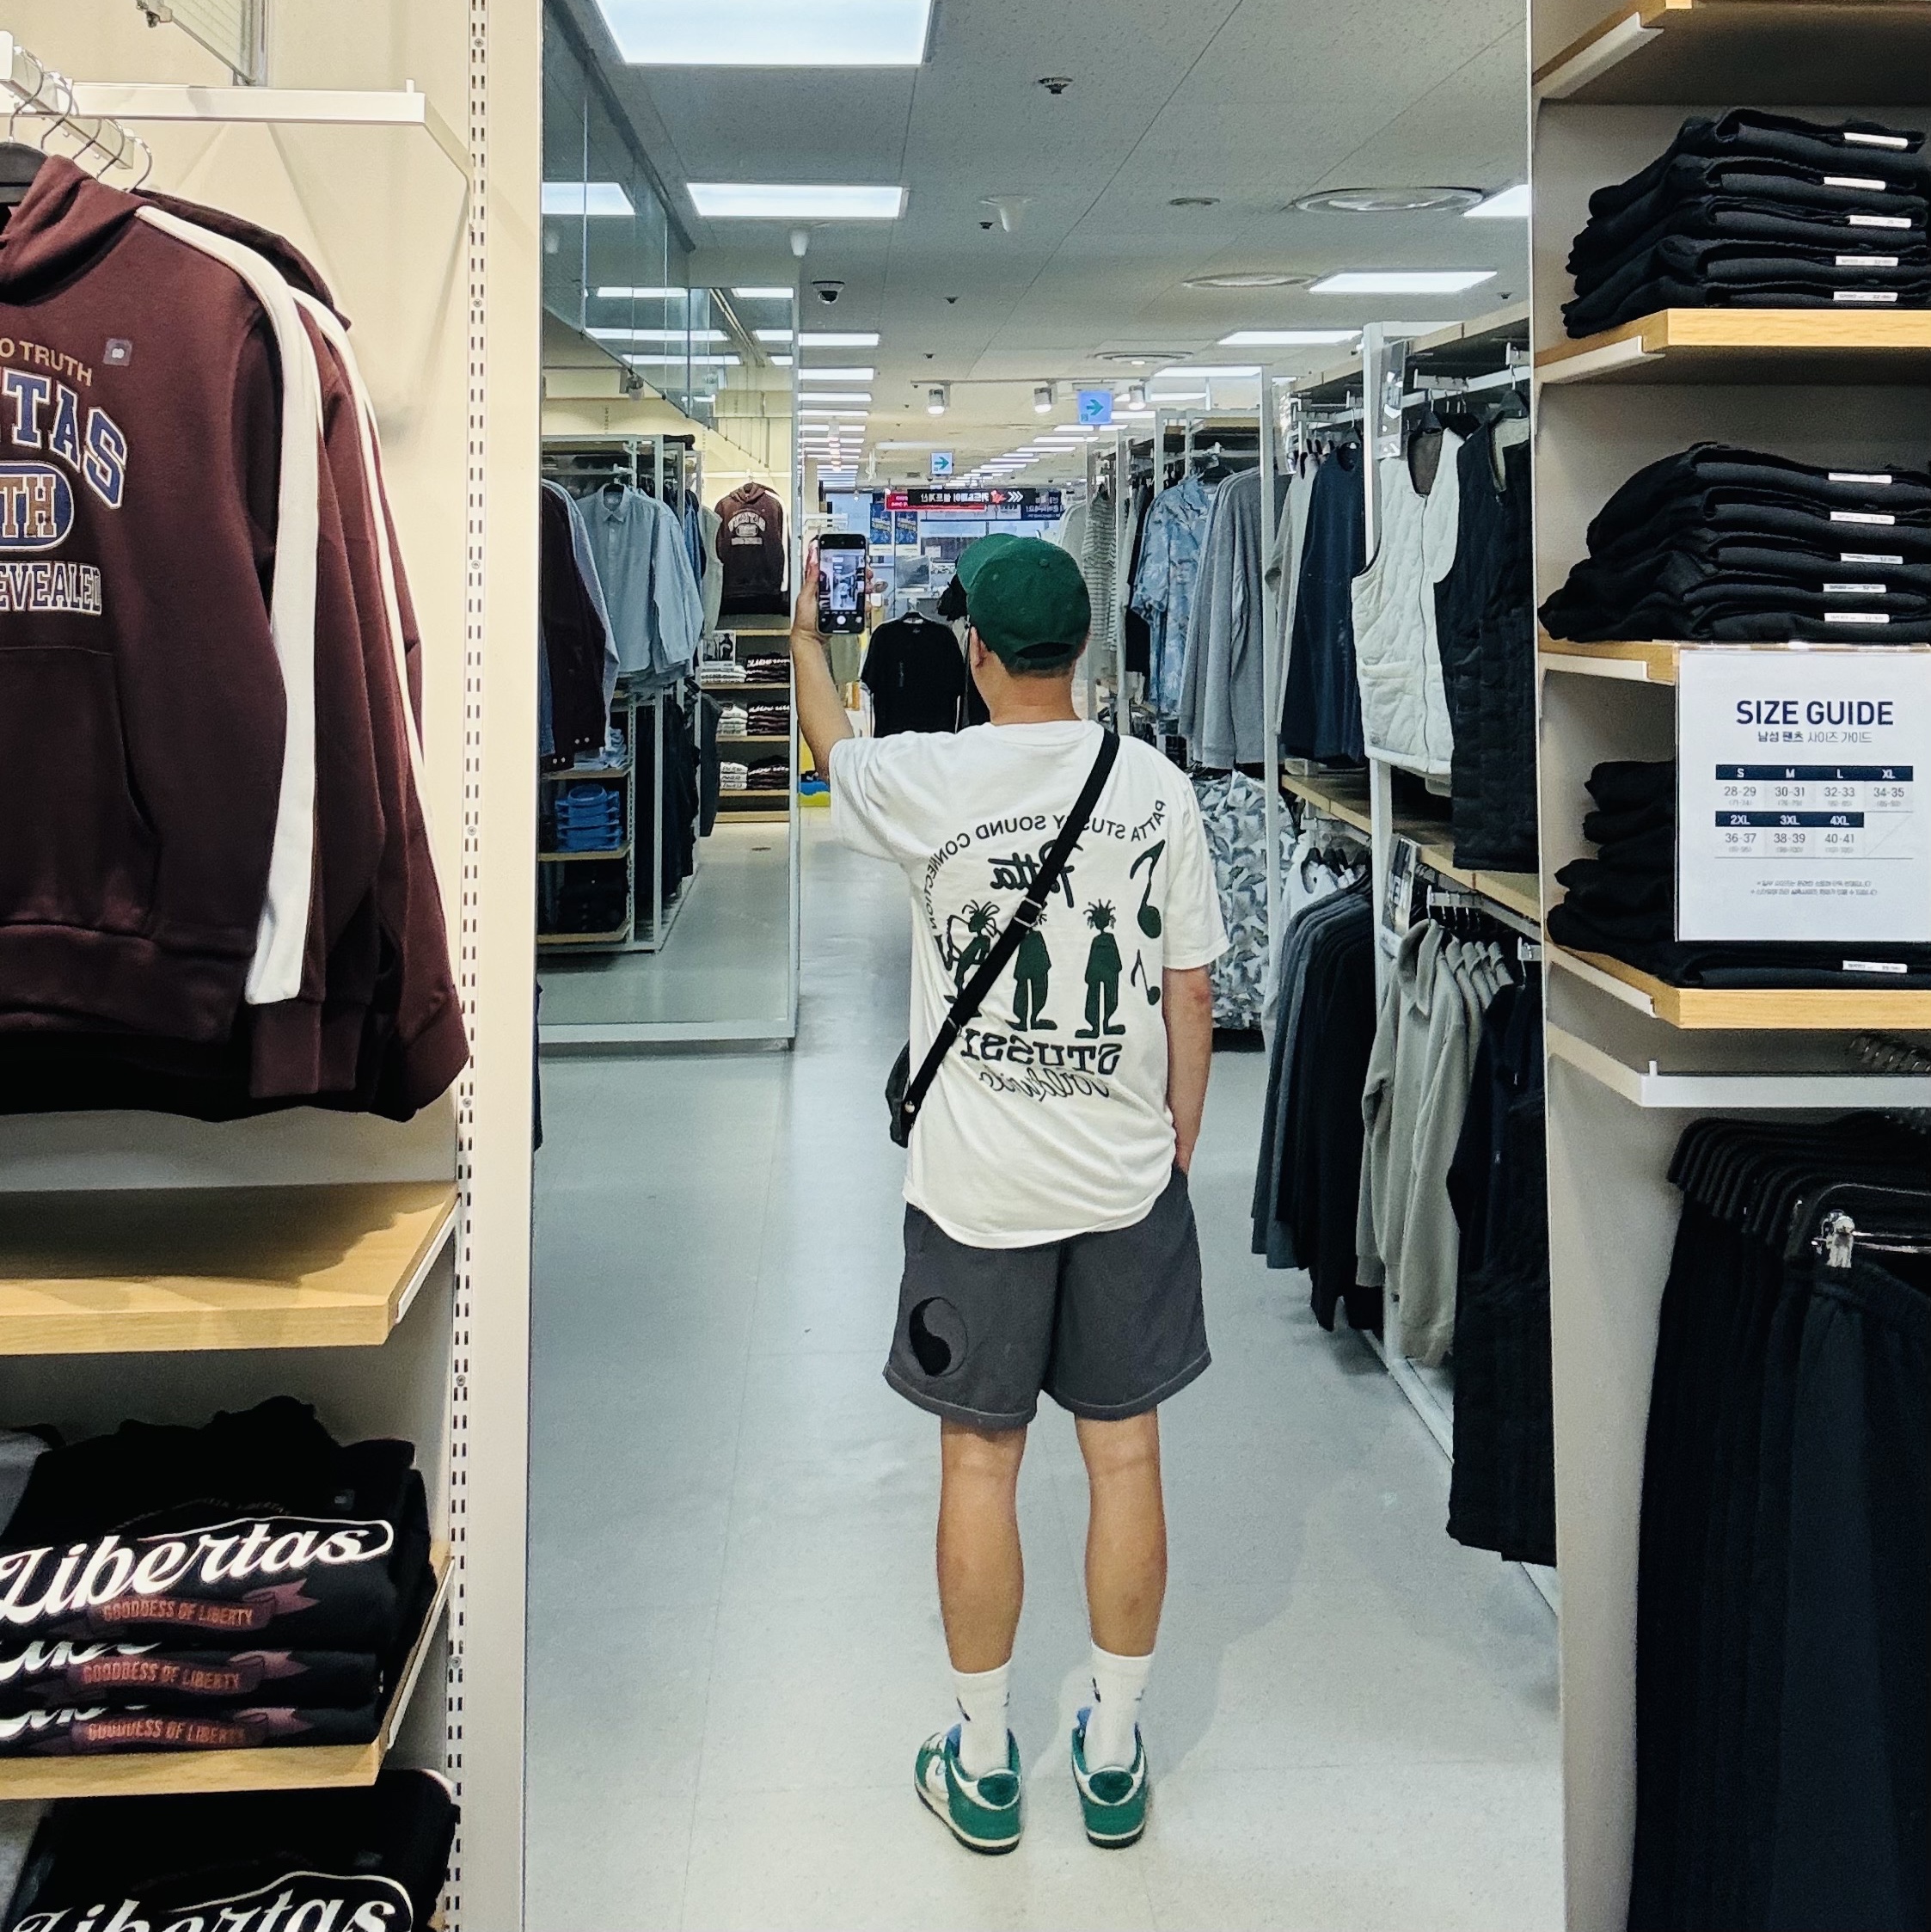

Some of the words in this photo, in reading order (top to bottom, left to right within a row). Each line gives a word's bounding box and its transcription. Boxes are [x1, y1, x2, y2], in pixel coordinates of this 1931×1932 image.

[19, 340, 92, 387] TRUTH
[0, 366, 127, 509] TAS
[1736, 700, 1799, 725] SIZE
[1806, 701, 1894, 725] GUIDE
[1757, 732, 1779, 743] 남성
[1782, 732, 1804, 743] 팬츠
[1808, 732, 1838, 743] 사이즈
[1842, 732, 1873, 744] 가이드
[1737, 768, 1744, 778] S
[1786, 768, 1795, 778] M
[1836, 769, 1843, 779] L
[1882, 769, 1896, 780] XL
[1724, 786, 1756, 796] 28-29
[1775, 787, 1805, 797] 30-31
[1824, 787, 1855, 797] 32-33
[1873, 787, 1904, 798] 34-35
[1731, 815, 1750, 825] 2XL
[1780, 815, 1799, 825] 3XL
[1830, 816, 1849, 825] 4XL
[1725, 833, 1756, 843] 36-37
[1774, 833, 1805, 843] 38-39
[1824, 834, 1854, 843] 40-41
[0, 1516, 394, 1623] Libertas
[178, 1602, 197, 1620] OF
[199, 1605, 253, 1626] LIBERTY
[161, 1664, 180, 1683] OF
[182, 1669, 239, 1689] LIBERTY
[166, 1720, 186, 1739] OF
